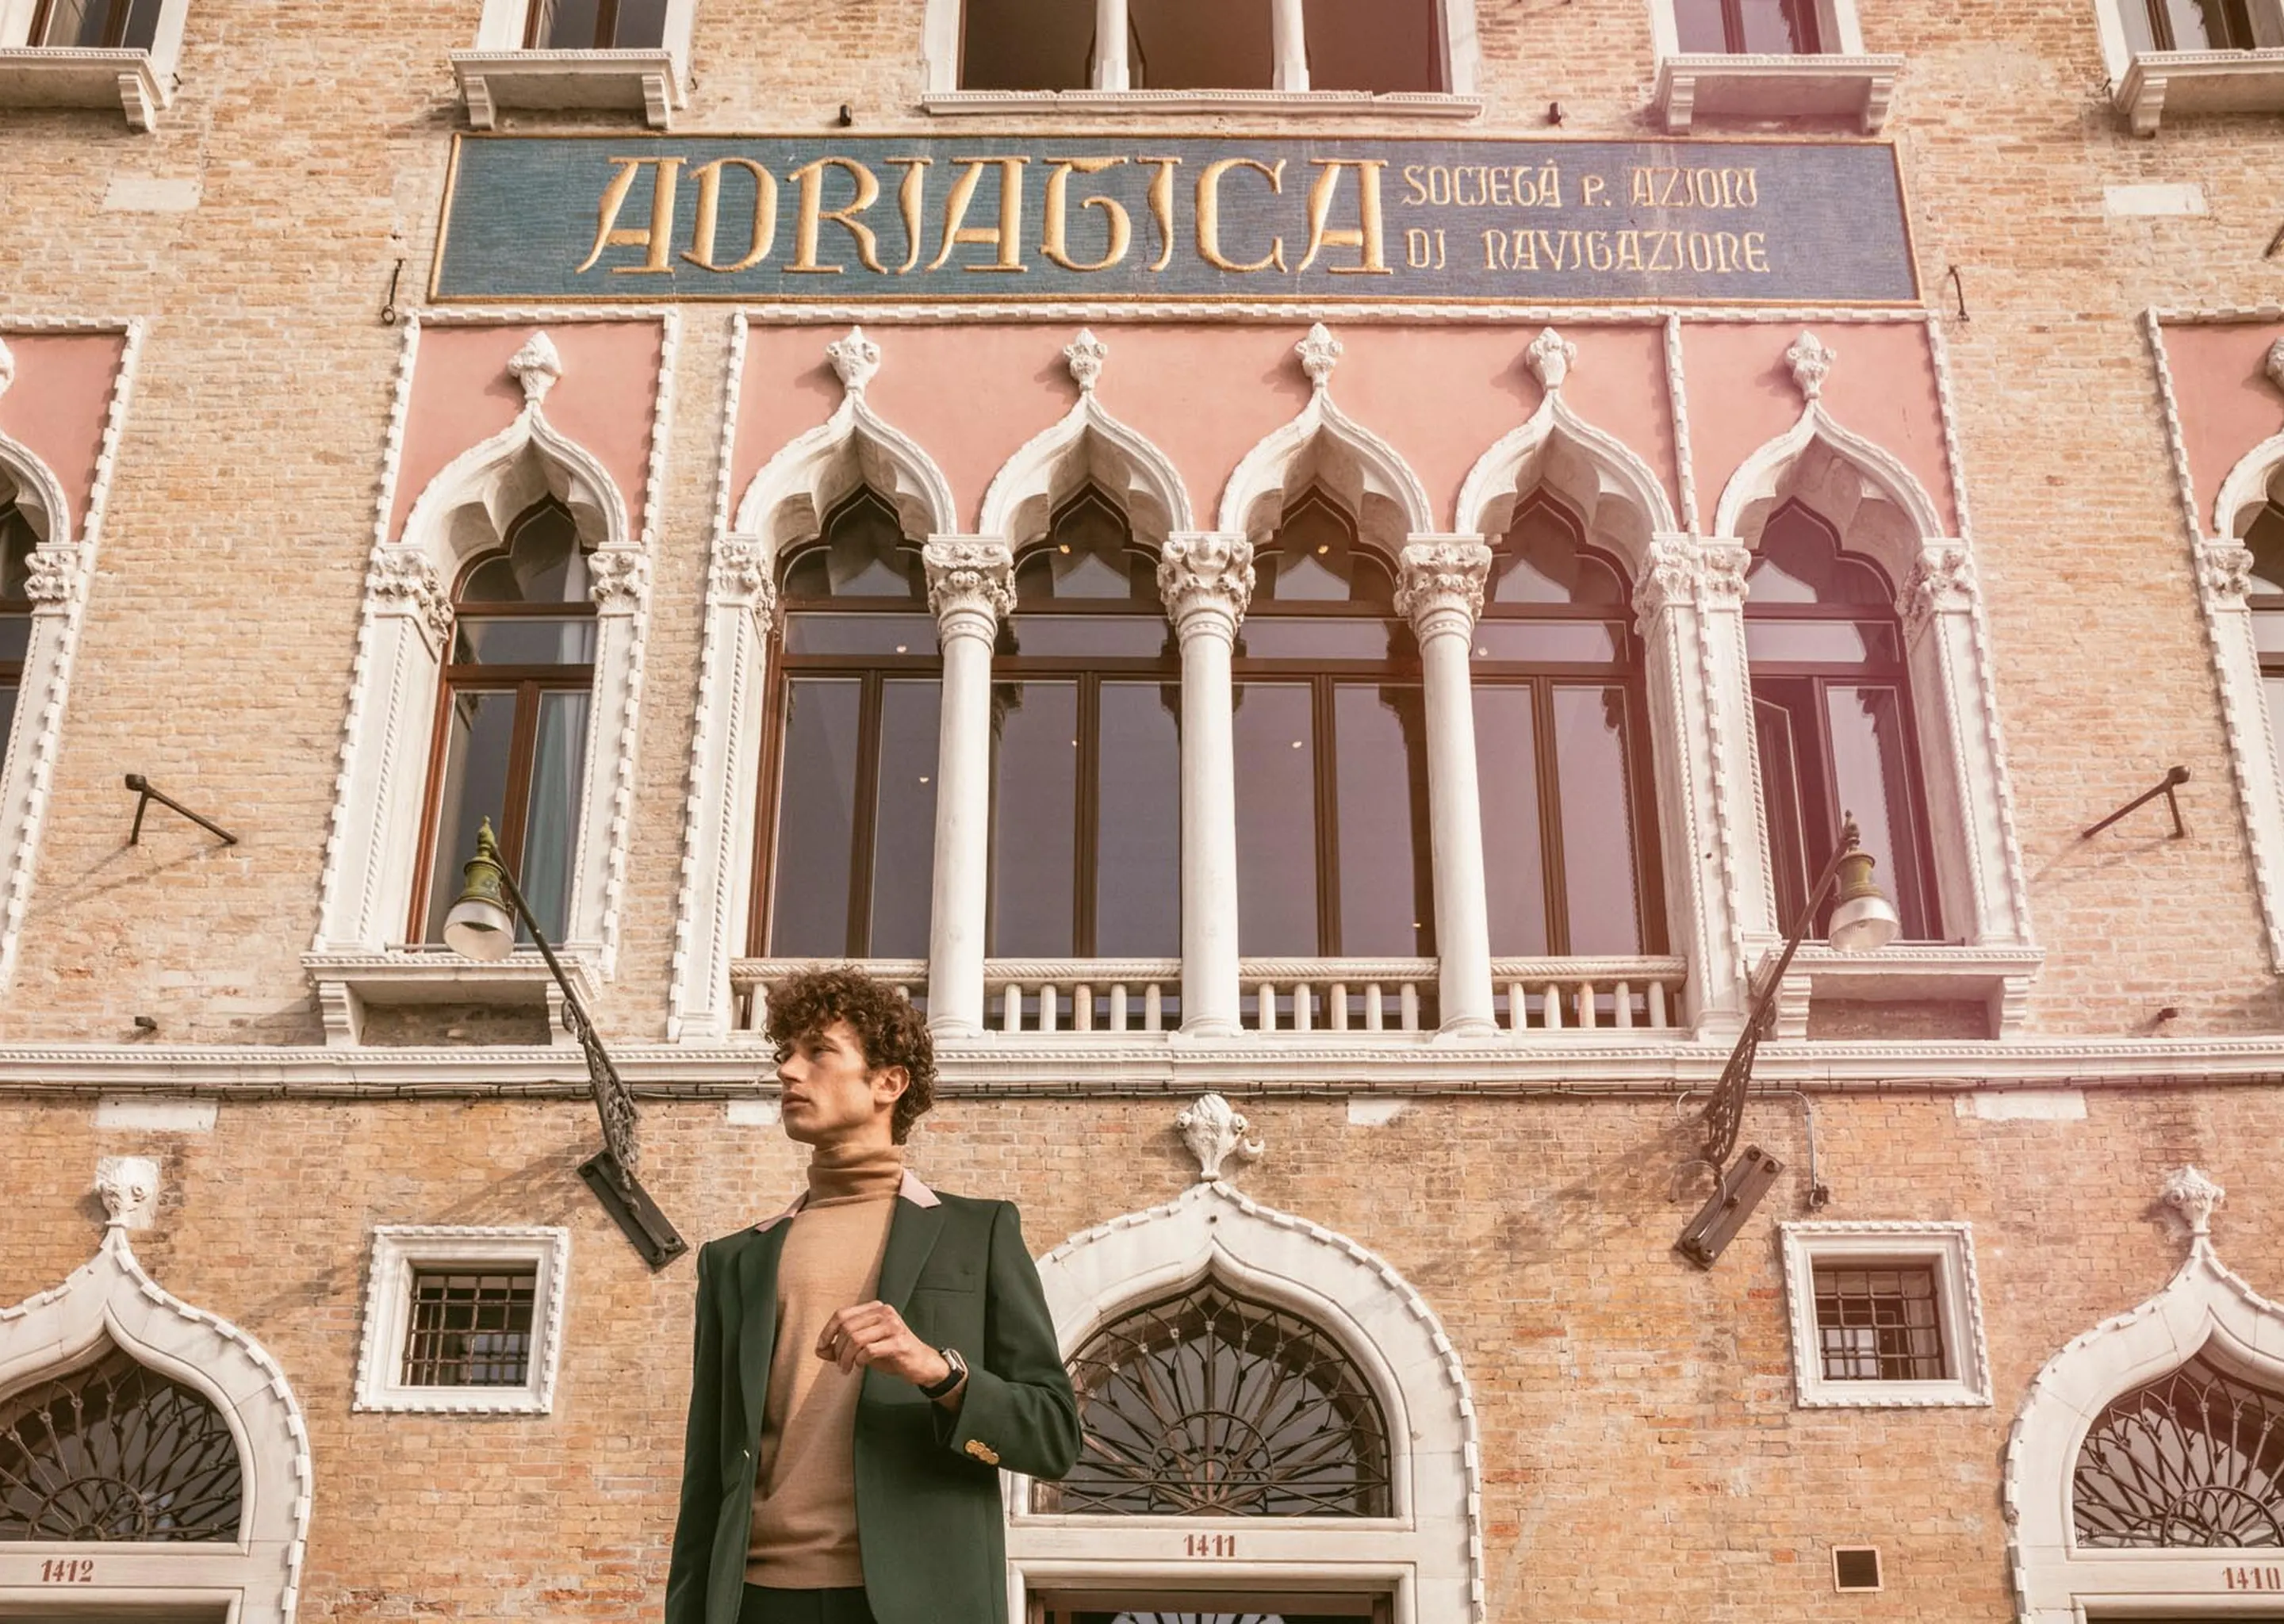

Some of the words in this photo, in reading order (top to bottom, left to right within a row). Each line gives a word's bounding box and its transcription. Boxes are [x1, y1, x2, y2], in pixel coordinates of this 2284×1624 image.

[1630, 167, 1757, 208] AZIONI
[575, 156, 1393, 274] ADRIATICA
[1405, 228, 1447, 270] DI
[1481, 228, 1771, 274] NAVIGAZIONE
[1183, 1534, 1236, 1557] 1411
[41, 1559, 94, 1583] 1412
[2221, 1566, 2282, 1590] 1410
